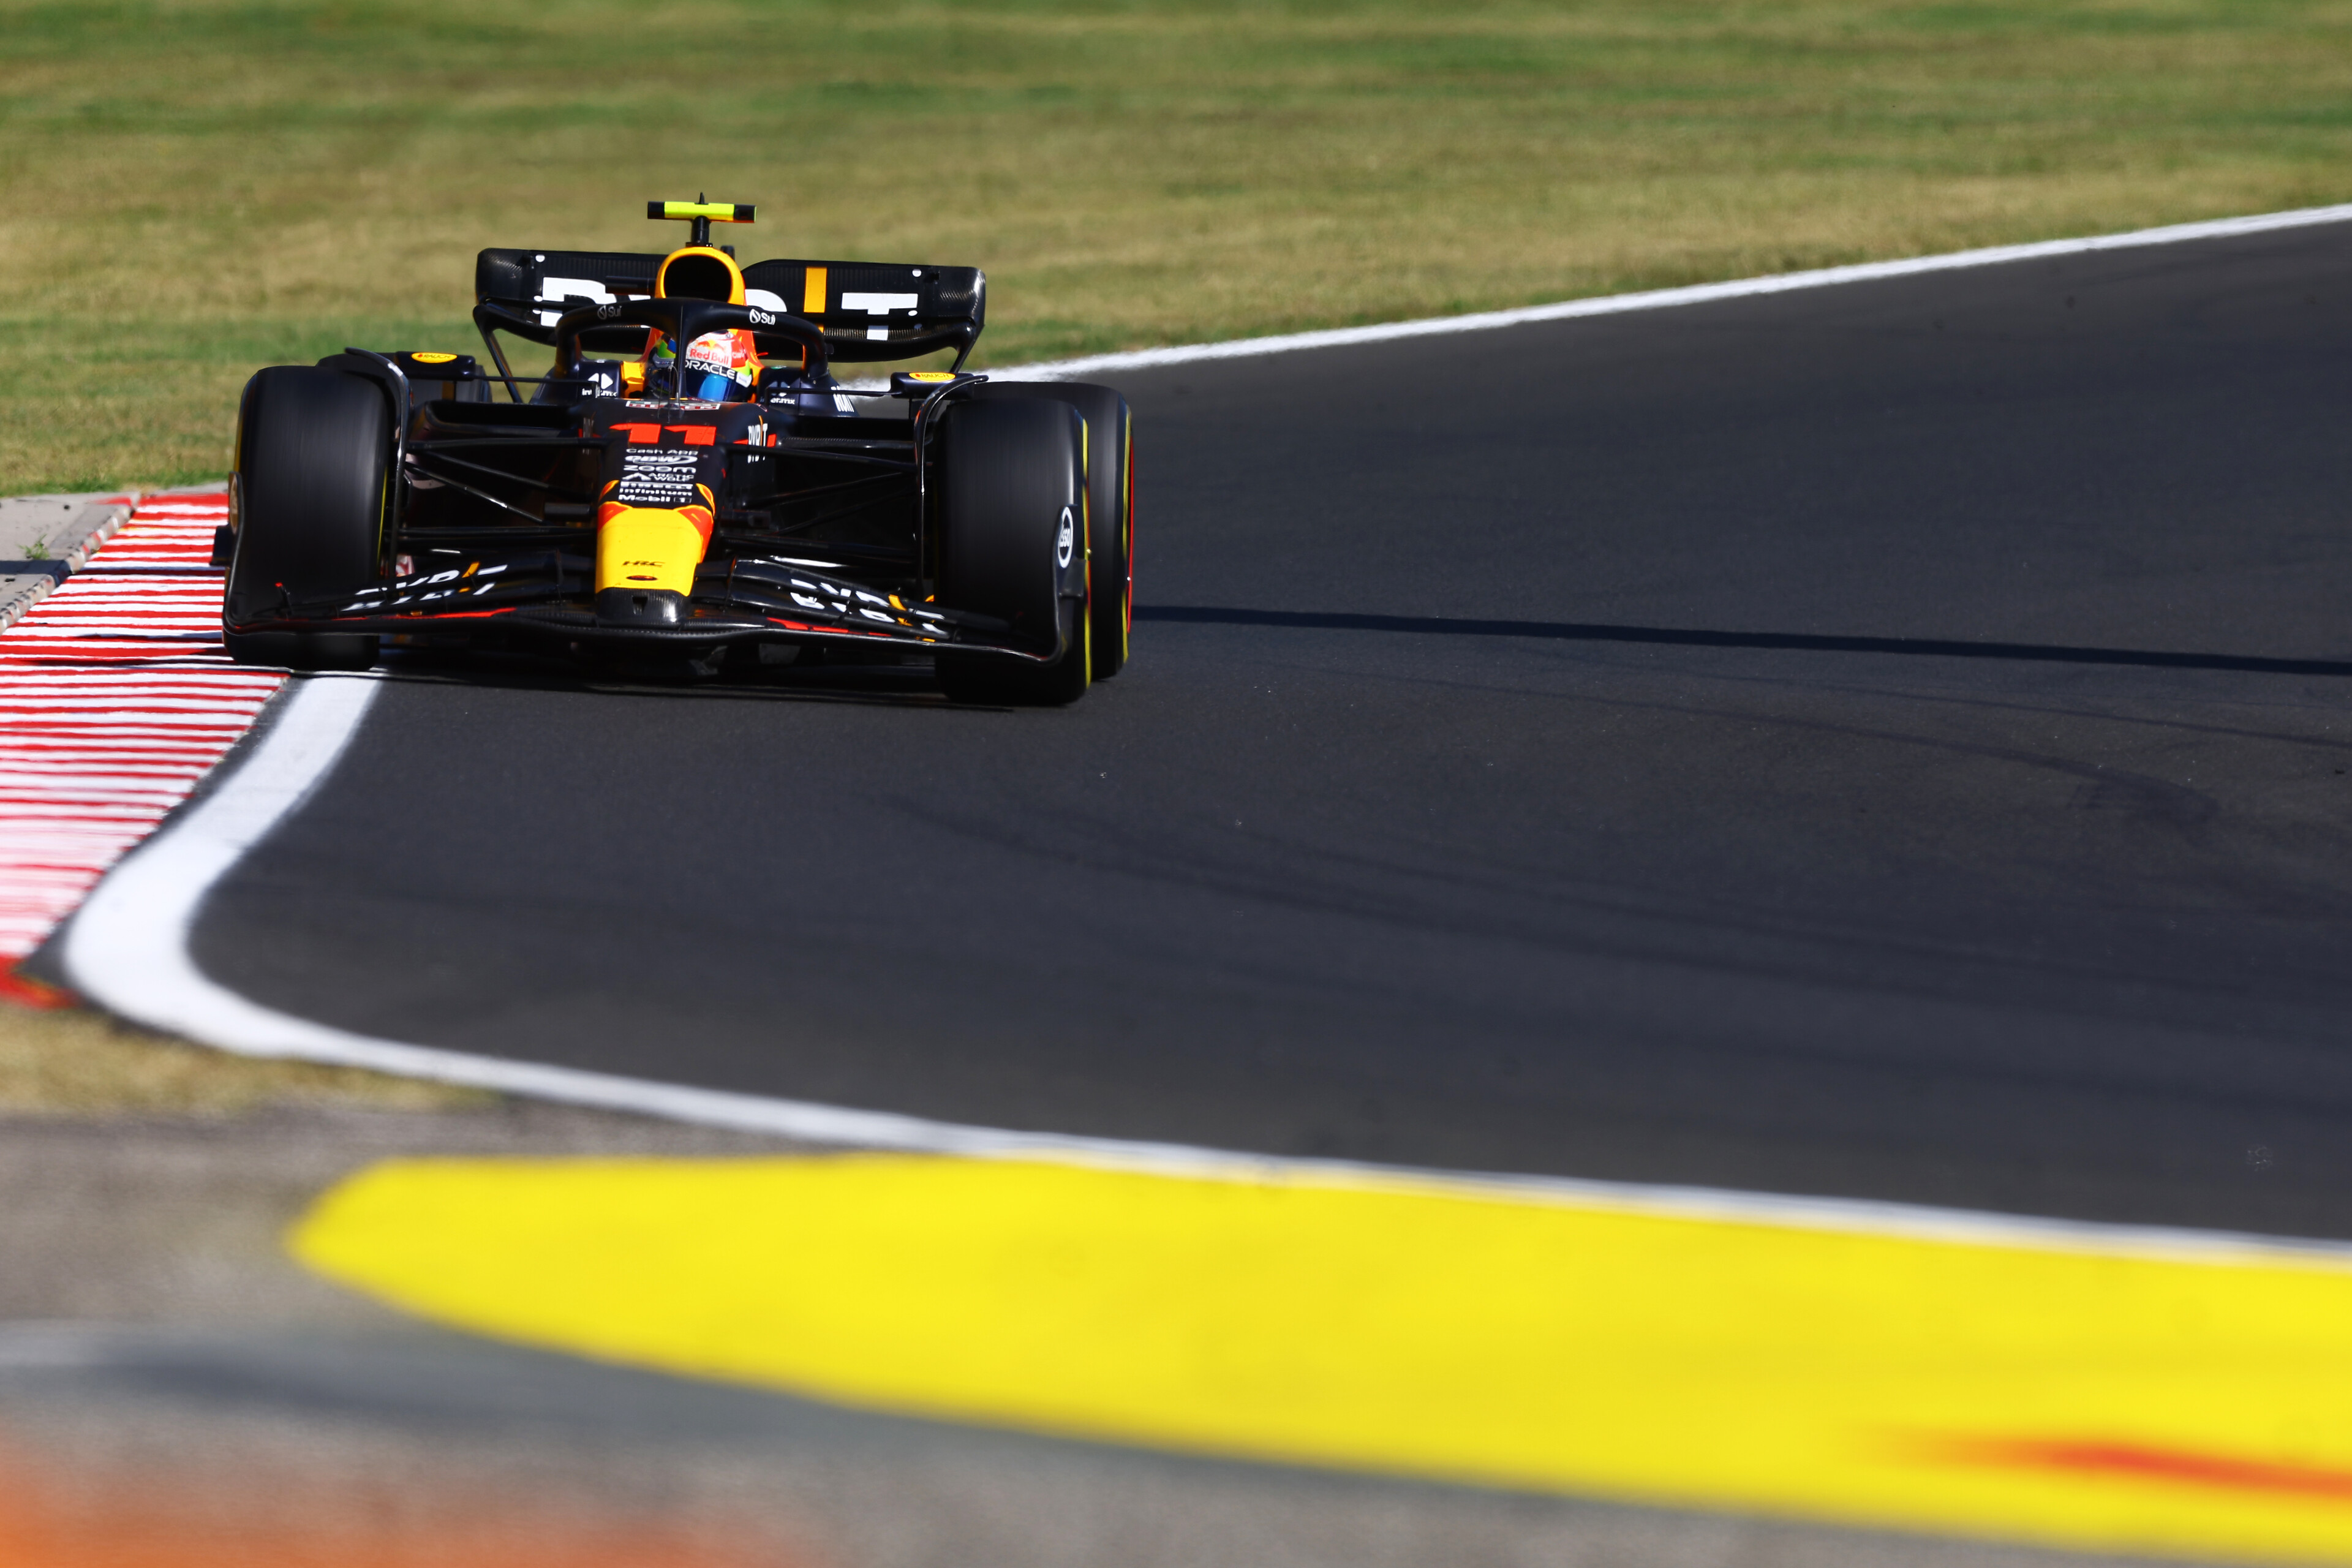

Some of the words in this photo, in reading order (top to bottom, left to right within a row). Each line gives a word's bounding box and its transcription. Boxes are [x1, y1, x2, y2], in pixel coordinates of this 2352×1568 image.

[608, 306, 622, 317] Sui
[761, 312, 775, 325] Sui
[690, 349, 709, 360] Red
[712, 353, 729, 364] Bull
[609, 423, 717, 446] 11
[624, 465, 696, 473] zoom
